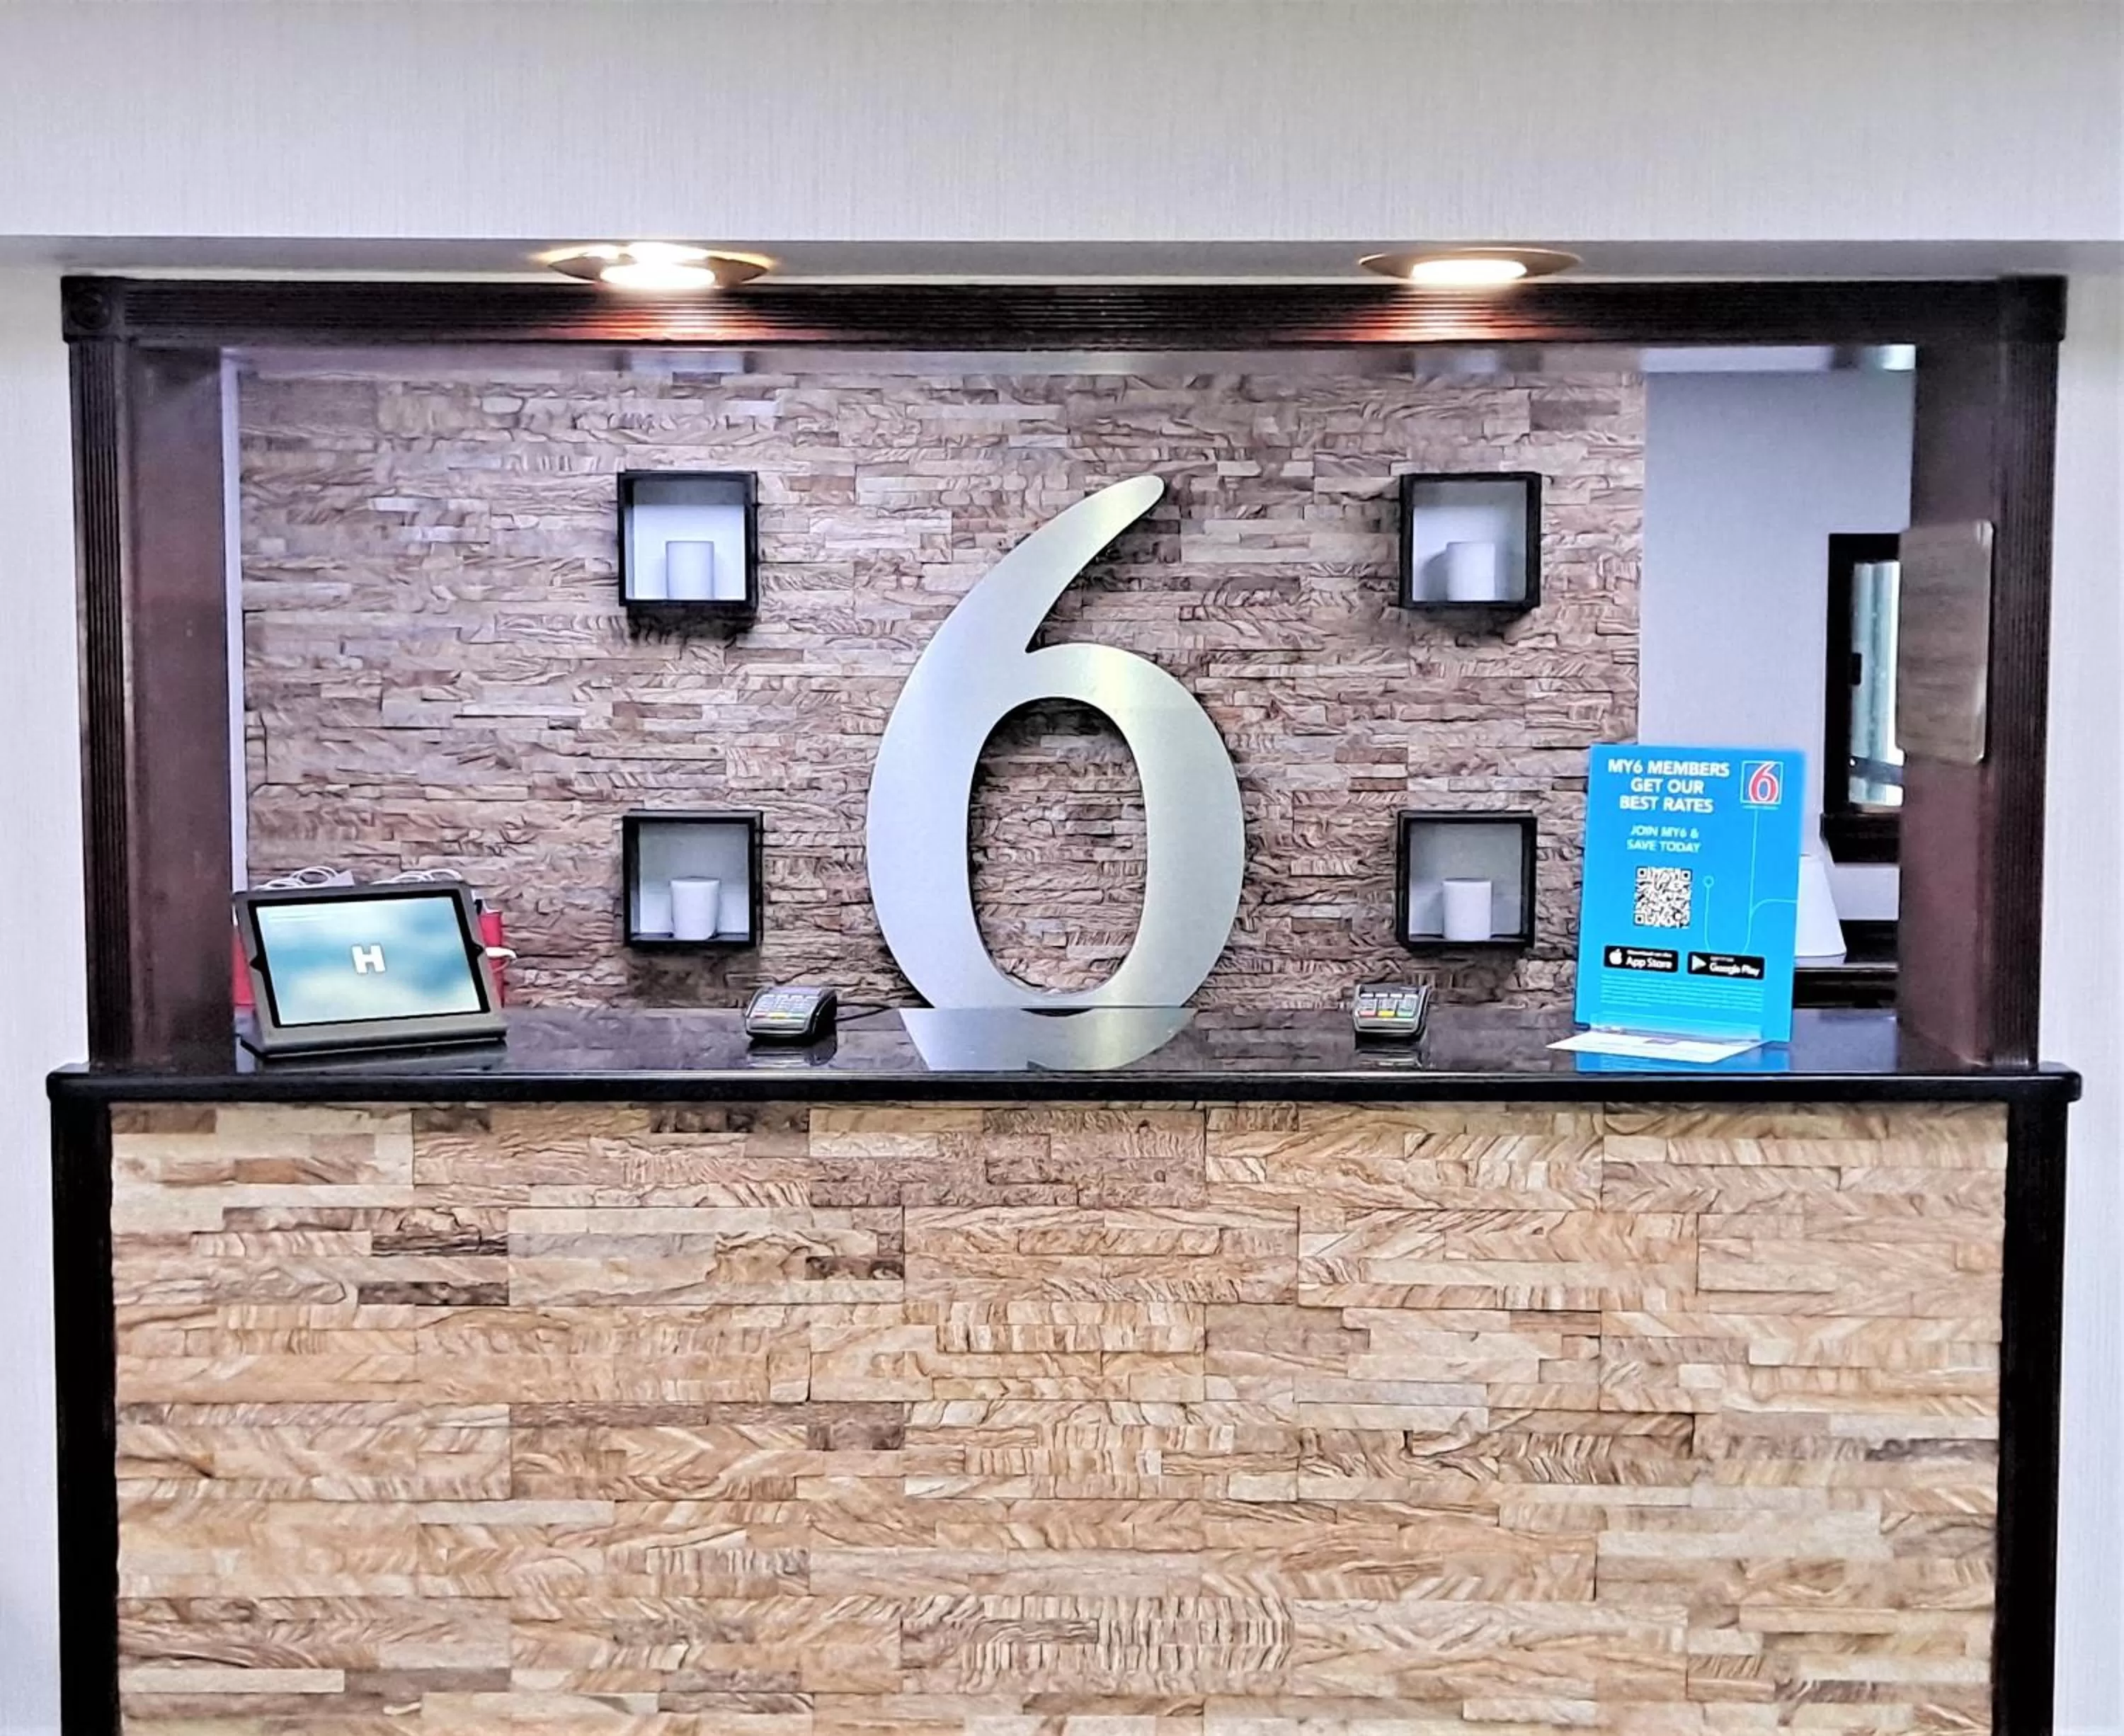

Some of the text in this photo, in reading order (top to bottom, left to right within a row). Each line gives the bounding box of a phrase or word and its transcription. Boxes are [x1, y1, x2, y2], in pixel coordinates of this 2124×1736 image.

[867, 474, 1244, 1008] 6
[1608, 758, 1730, 778] MY6 MEMBERS
[1631, 777, 1705, 794] GET OUR
[1749, 760, 1779, 804] 6
[1619, 794, 1714, 813] BEST RATES
[1631, 825, 1658, 837] JOIN
[1661, 826, 1687, 838] MY6
[1626, 838, 1701, 853] SAVE TODAY
[351, 944, 386, 974] H
[1626, 956, 1673, 969] App Store
[1709, 962, 1761, 977] Google Play
